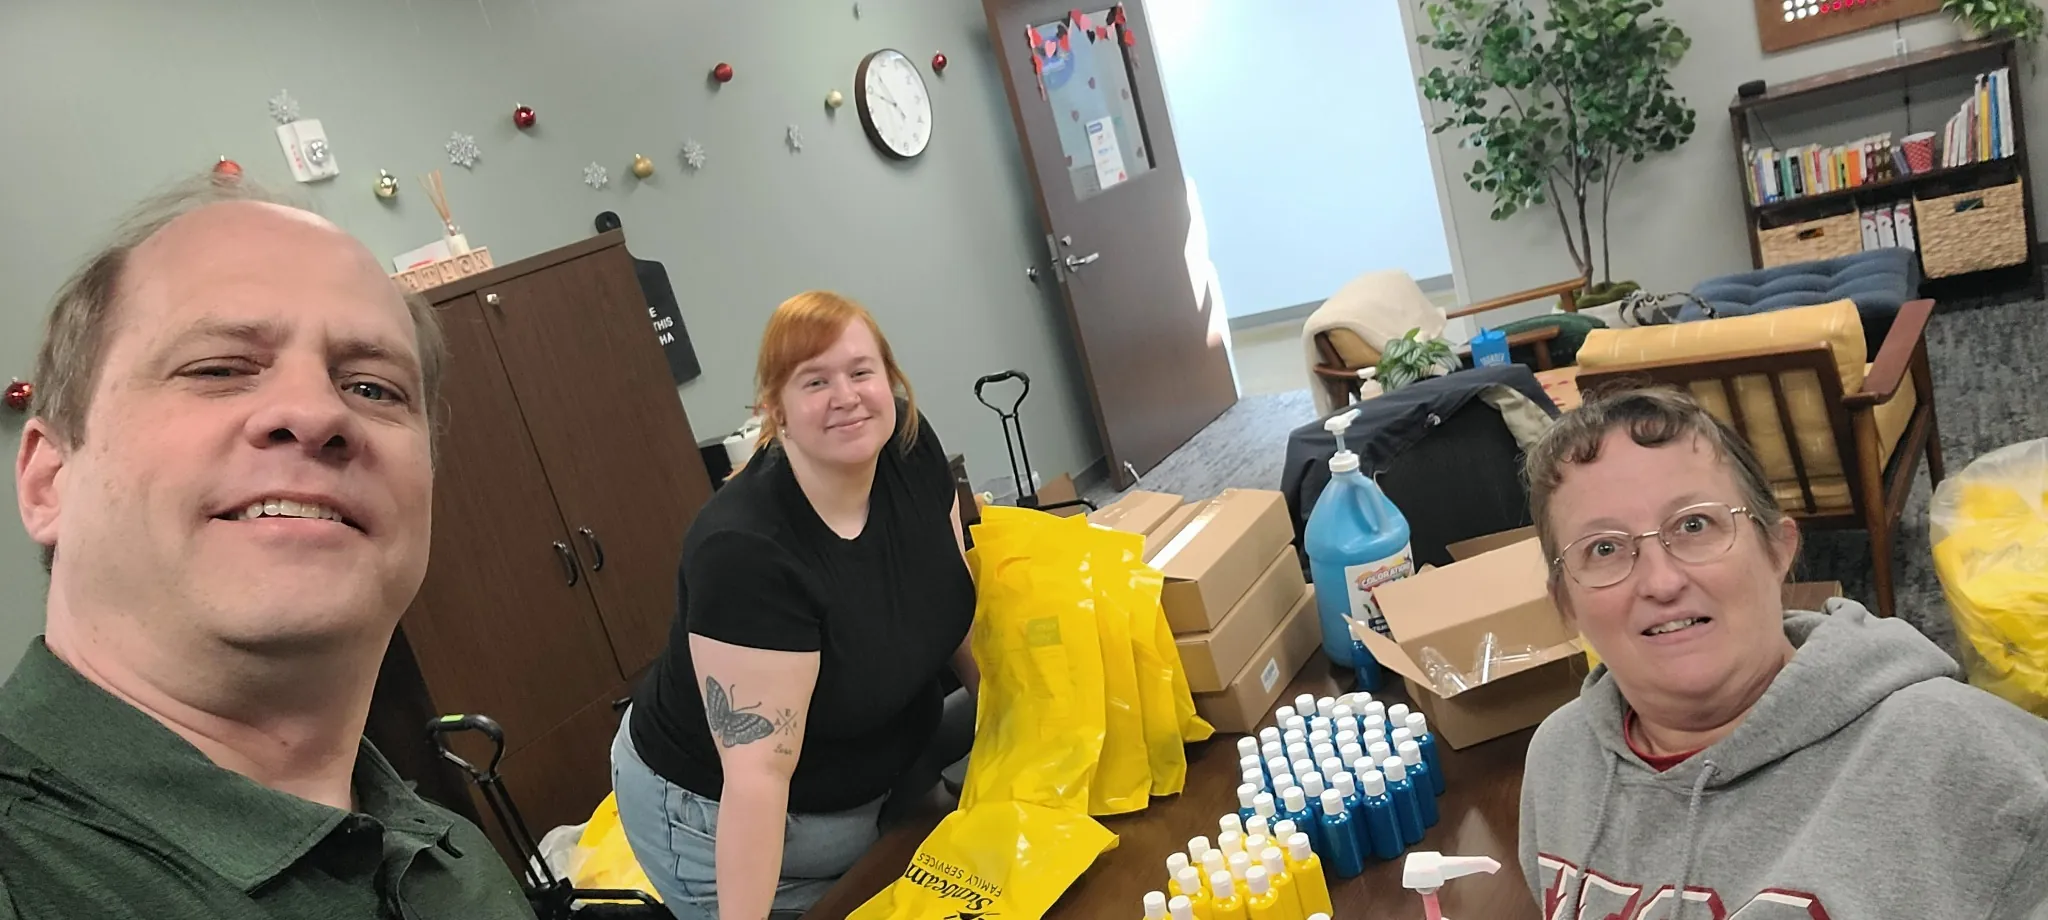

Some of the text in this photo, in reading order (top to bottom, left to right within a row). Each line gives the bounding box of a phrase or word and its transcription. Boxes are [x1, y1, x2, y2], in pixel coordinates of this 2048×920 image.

[648, 306, 657, 318] E
[653, 316, 674, 331] THIS
[659, 332, 675, 346] HA
[917, 852, 1003, 898] FAMILY SERVICES
[905, 862, 994, 911] Sunbeam
